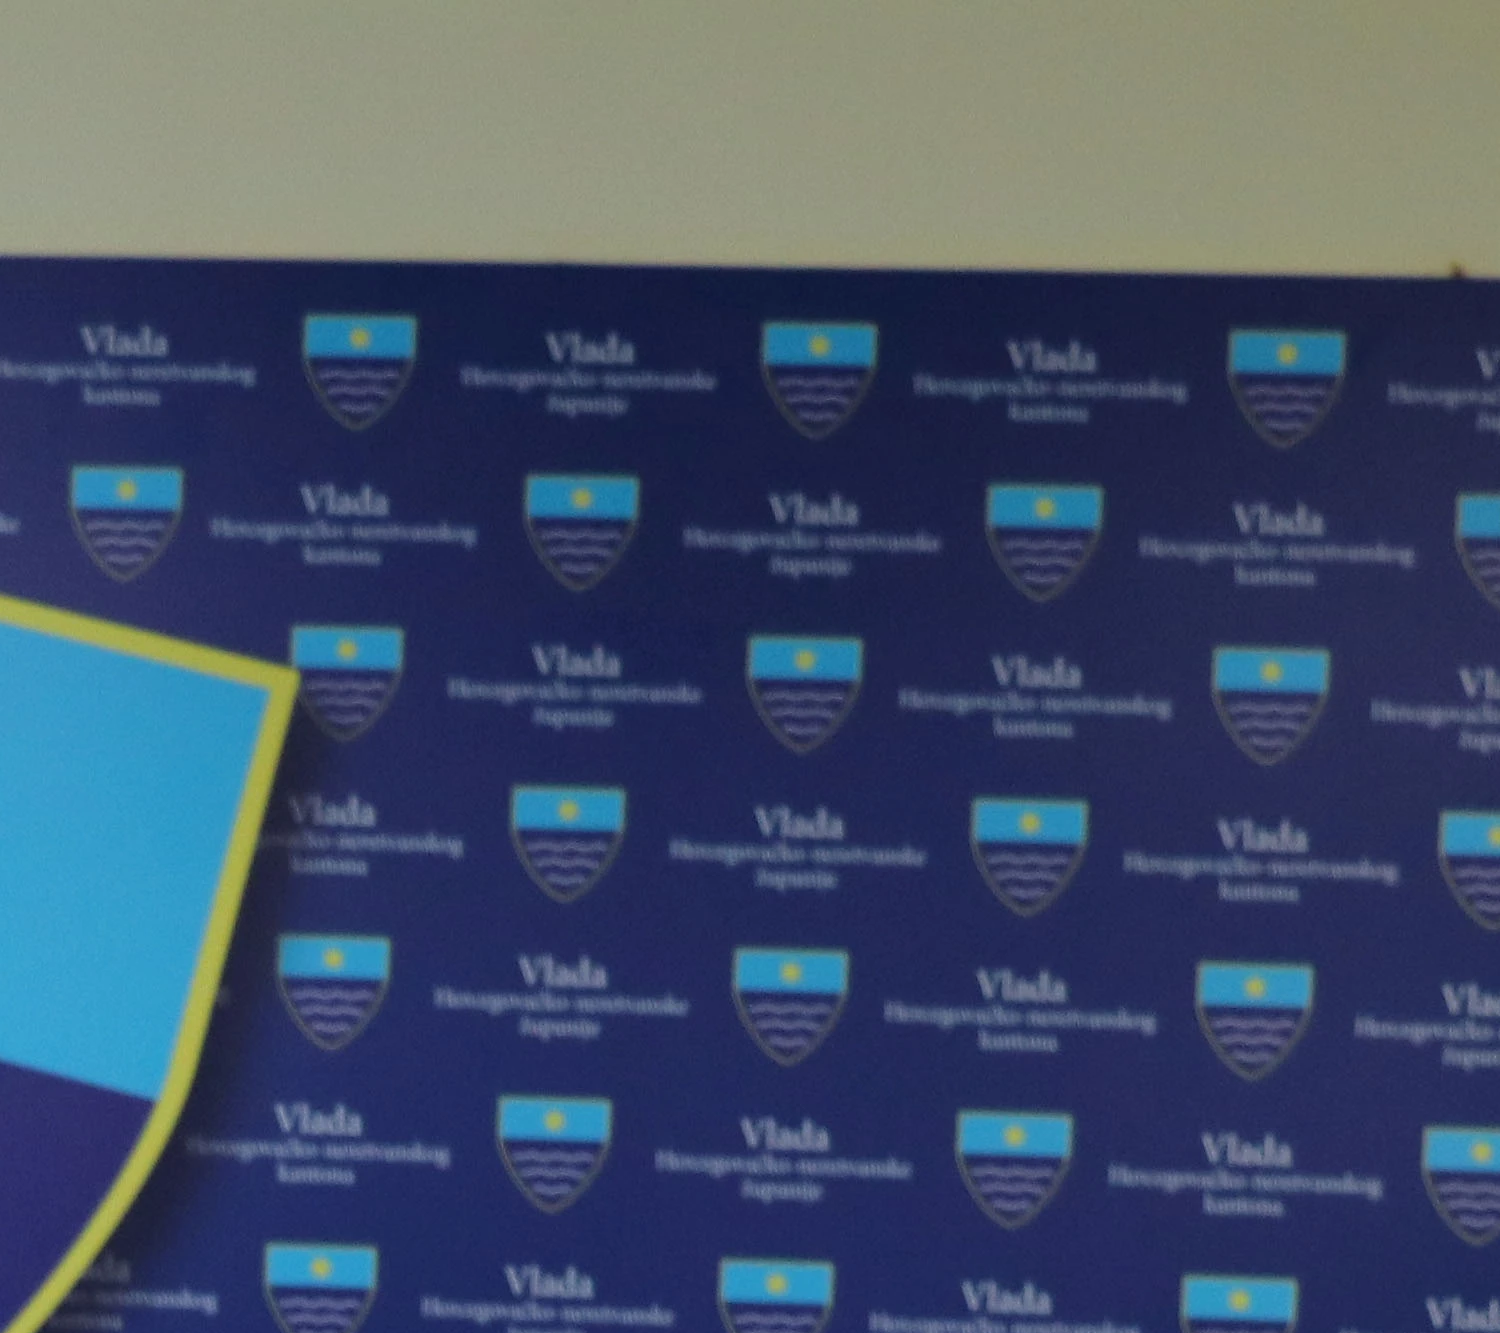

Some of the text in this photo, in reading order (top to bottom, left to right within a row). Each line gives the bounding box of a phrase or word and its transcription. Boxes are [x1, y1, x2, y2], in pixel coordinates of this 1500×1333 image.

[82, 324, 170, 358] Vlada
[546, 332, 636, 367] Vlada
[1008, 339, 1098, 374] Vlada
[301, 483, 390, 517] Vlada
[769, 493, 860, 528] Vlada
[1234, 502, 1325, 537] Vlada
[532, 644, 622, 679] Vlada
[992, 655, 1083, 690] Vlada
[288, 792, 377, 828] Vlada
[755, 805, 845, 840] Vlada
[1218, 818, 1310, 853] Vlada
[519, 954, 609, 989] Vlada
[978, 968, 1068, 1003] Vlada
[273, 1102, 363, 1137] Vlada
[740, 1116, 831, 1151] Vlada
[1203, 1132, 1294, 1167] Vlada
[505, 1264, 595, 1299] Vlada
[962, 1280, 1052, 1315] Vlada
